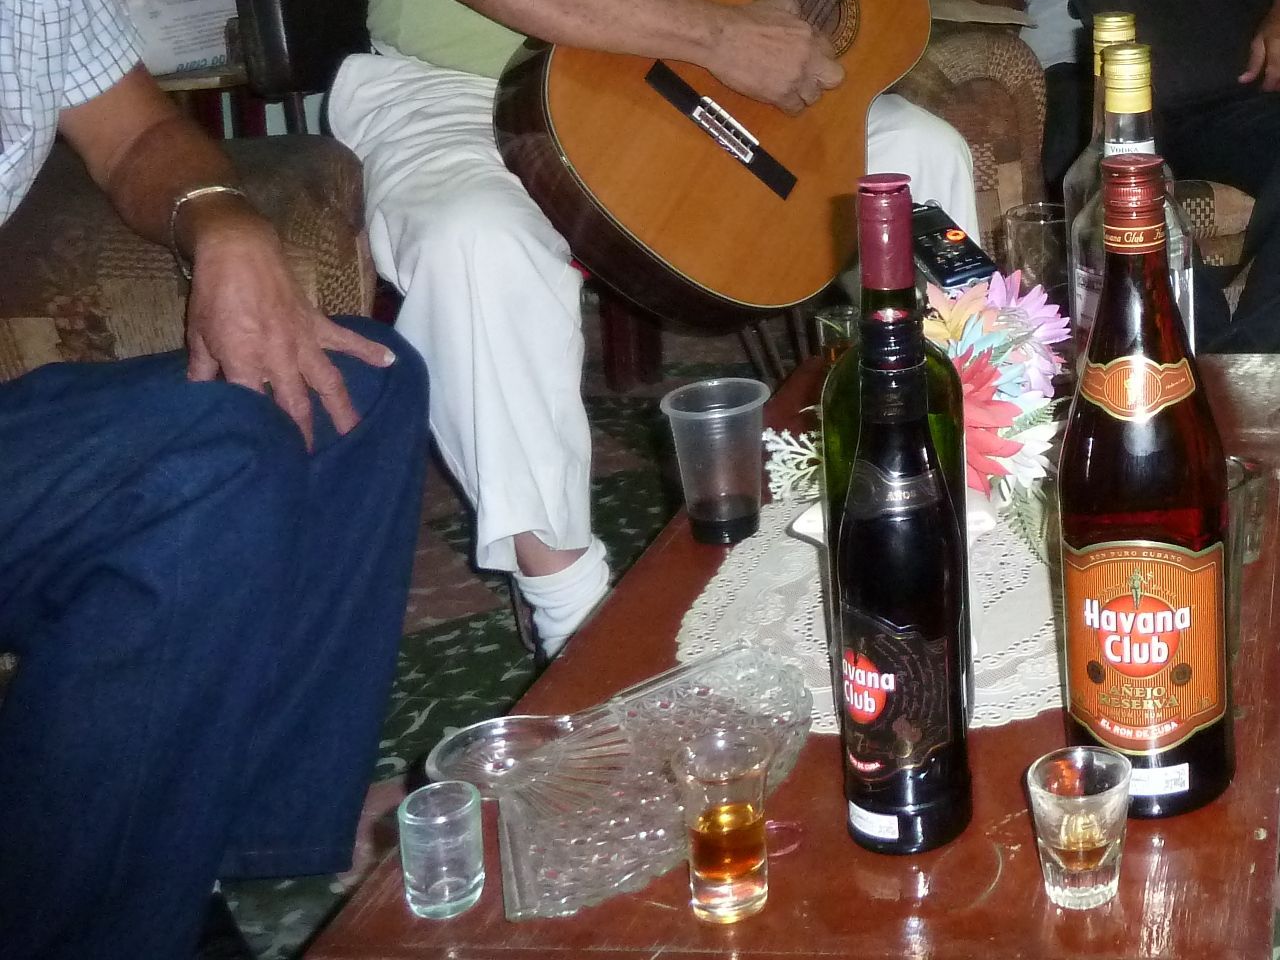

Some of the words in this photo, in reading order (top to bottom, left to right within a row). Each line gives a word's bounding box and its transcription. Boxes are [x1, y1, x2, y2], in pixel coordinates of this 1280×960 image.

[1109, 145, 1140, 153] VODKA
[1124, 231, 1144, 243] Club
[1089, 552, 1107, 561] RON
[1110, 550, 1137, 558] PURO
[1142, 551, 1183, 562] CUBANO
[1084, 598, 1191, 634] Havana
[1104, 634, 1170, 664] Club
[842, 658, 895, 690] avana
[844, 680, 876, 713] Club
[1108, 683, 1166, 700] AÑEJO
[1098, 693, 1180, 710] RESERVA
[1099, 719, 1112, 730] EL
[1112, 725, 1133, 737] RON
[1135, 729, 1150, 738] DE
[1150, 721, 1179, 737] CUBA
